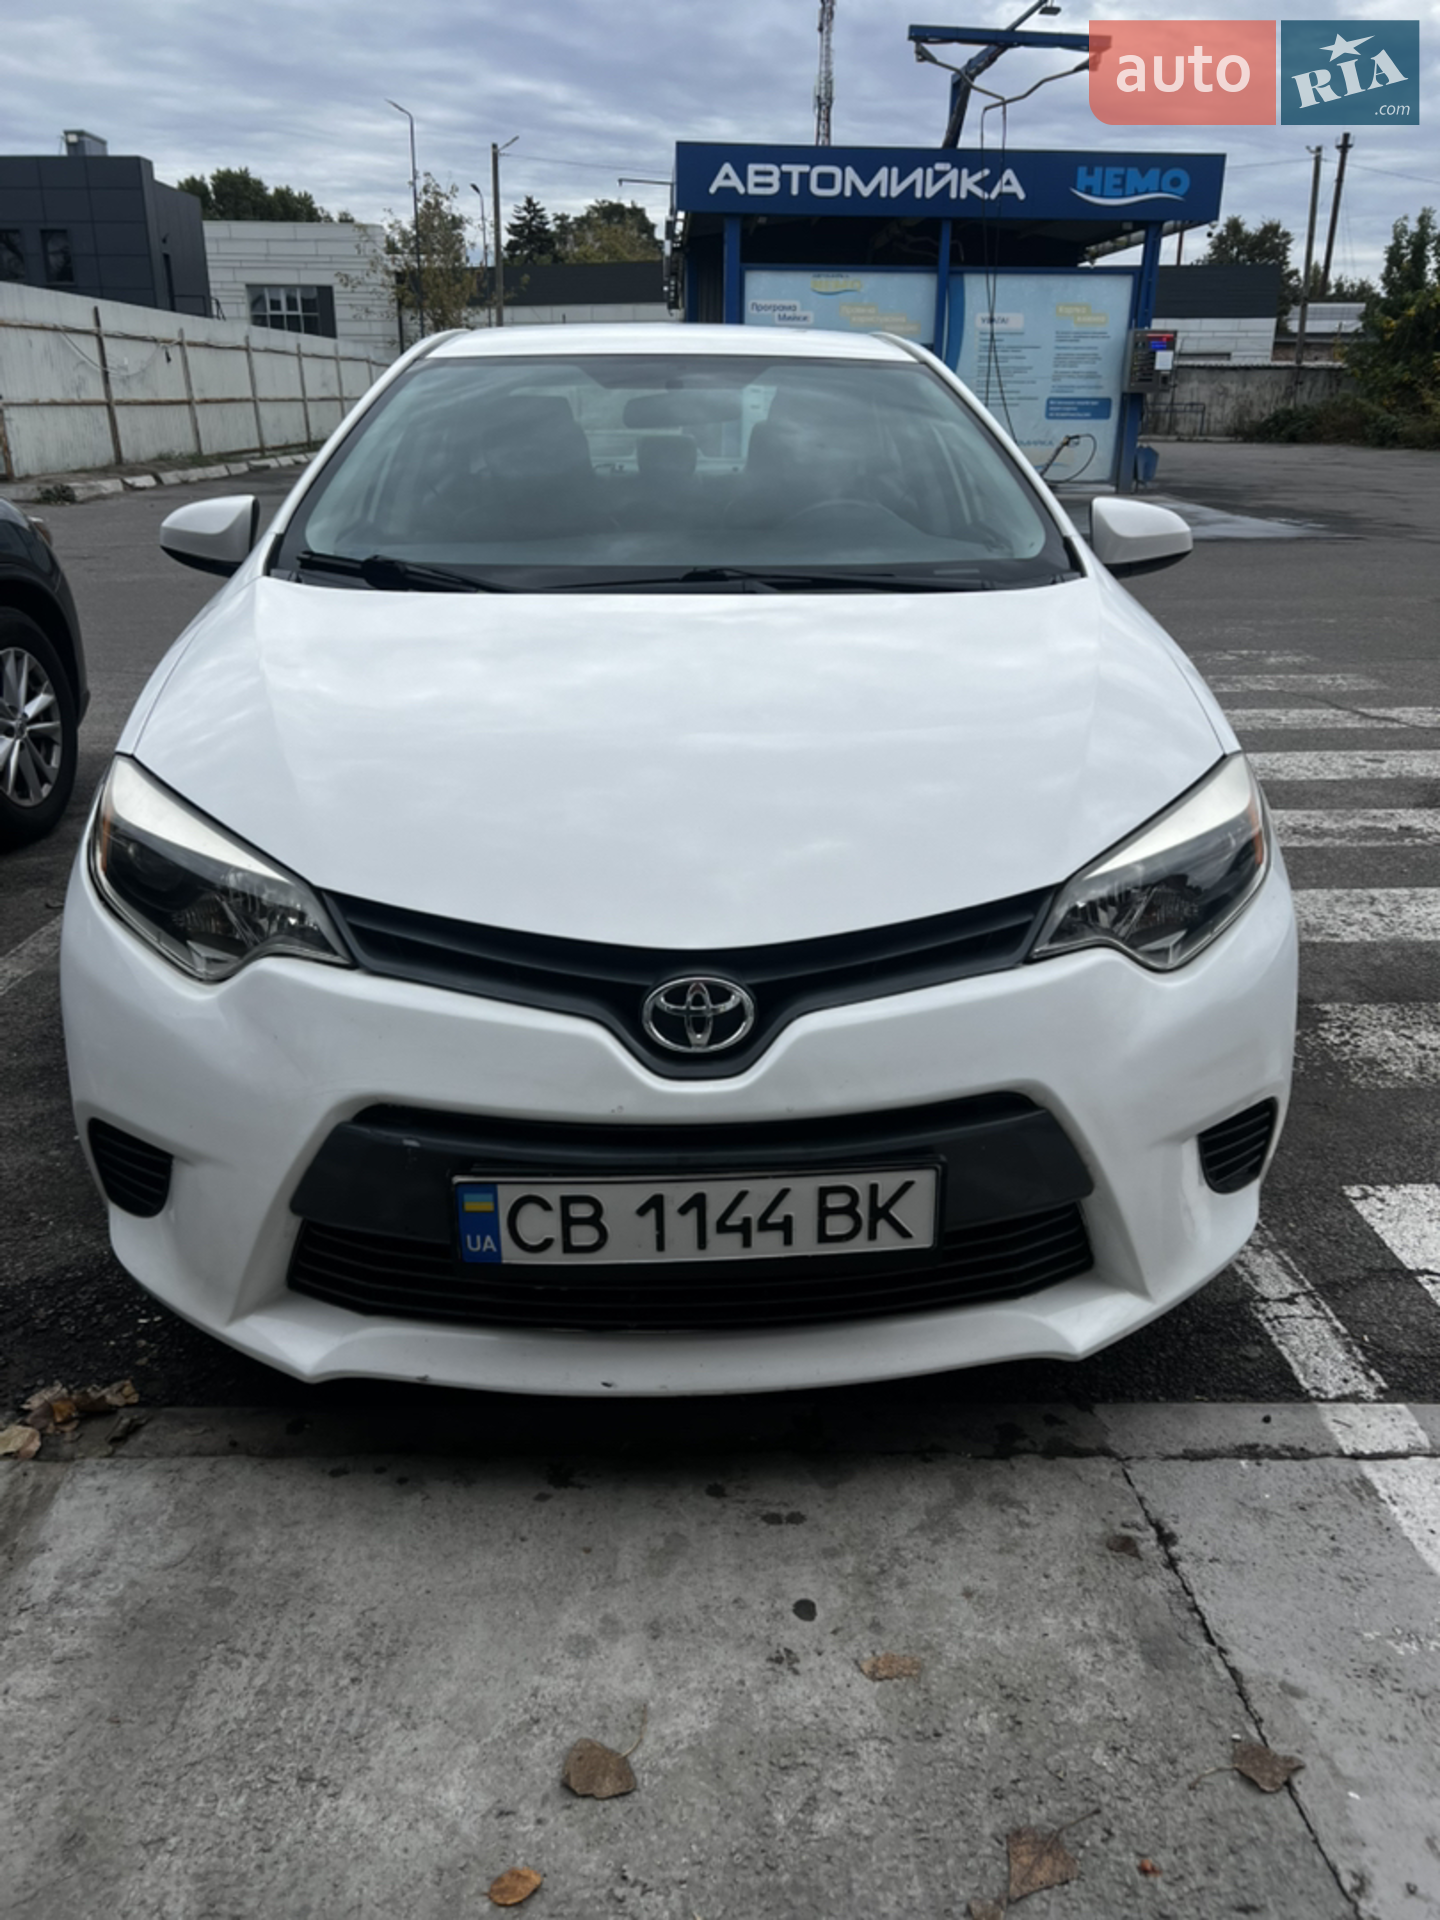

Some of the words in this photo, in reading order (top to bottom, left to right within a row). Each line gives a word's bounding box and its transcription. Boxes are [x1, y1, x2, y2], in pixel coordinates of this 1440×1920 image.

[709, 162, 1026, 200] АВТОМИЙКА
[1077, 166, 1190, 196] НЕМО
[507, 1194, 609, 1254] CB
[635, 1187, 793, 1253] 1144
[817, 1180, 916, 1244] BK
[466, 1235, 497, 1252] UA
